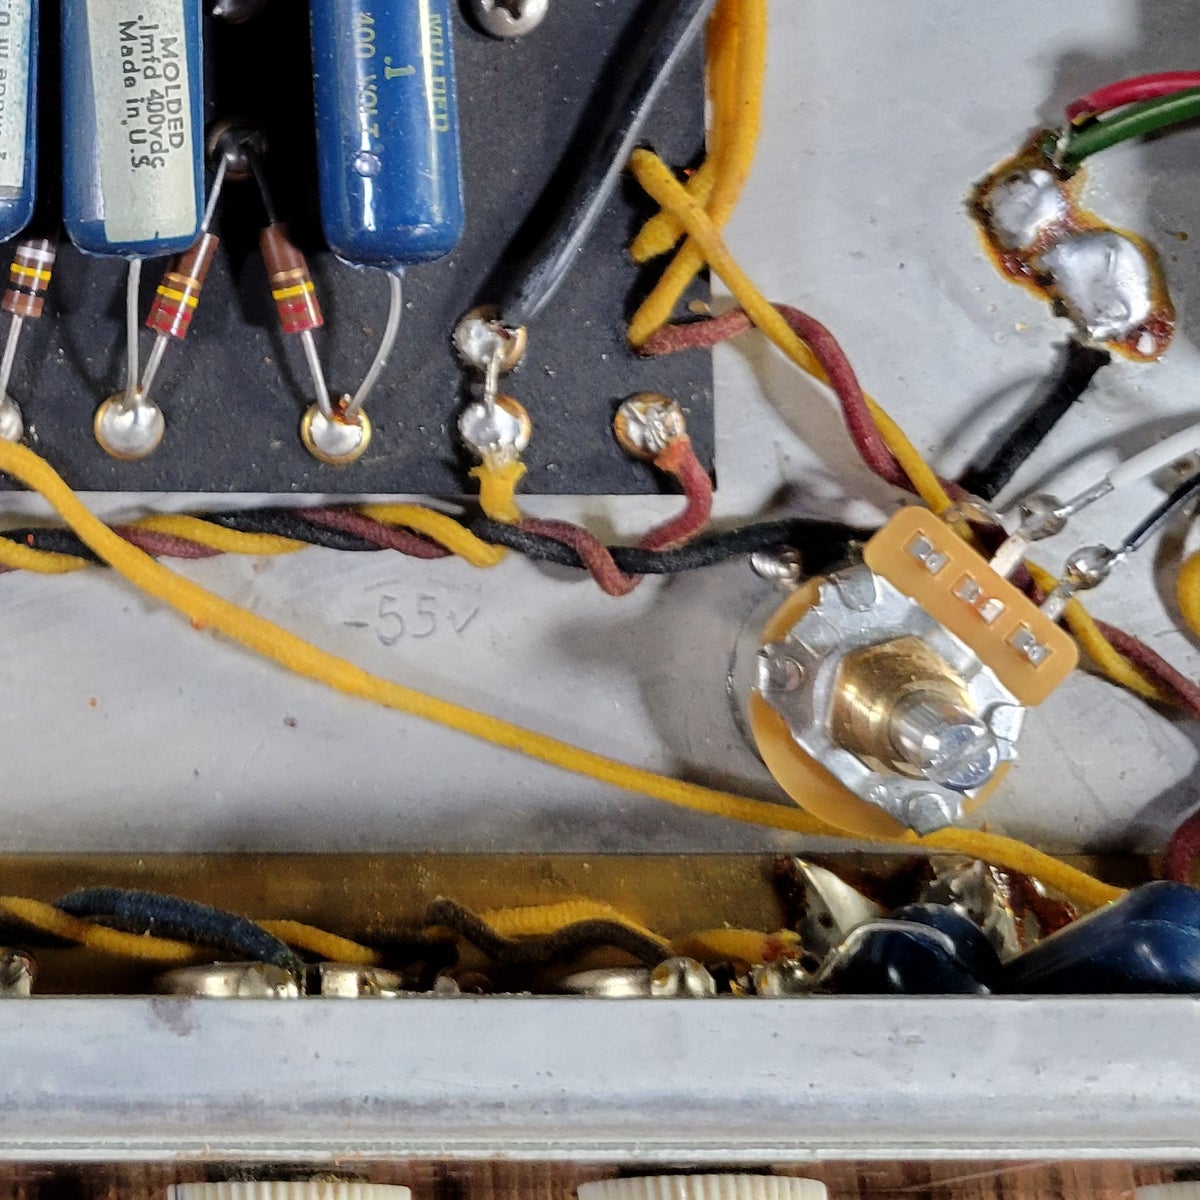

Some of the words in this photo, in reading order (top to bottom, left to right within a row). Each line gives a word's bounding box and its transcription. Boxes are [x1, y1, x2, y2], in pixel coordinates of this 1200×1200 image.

[119, 20, 141, 88] Made
[138, 15, 162, 79] .1mfd
[384, 56, 416, 80] .1
[127, 98, 144, 118] in
[161, 37, 184, 149] MOLDED
[129, 129, 150, 172] U.S.
[147, 89, 169, 169] 400vdc
